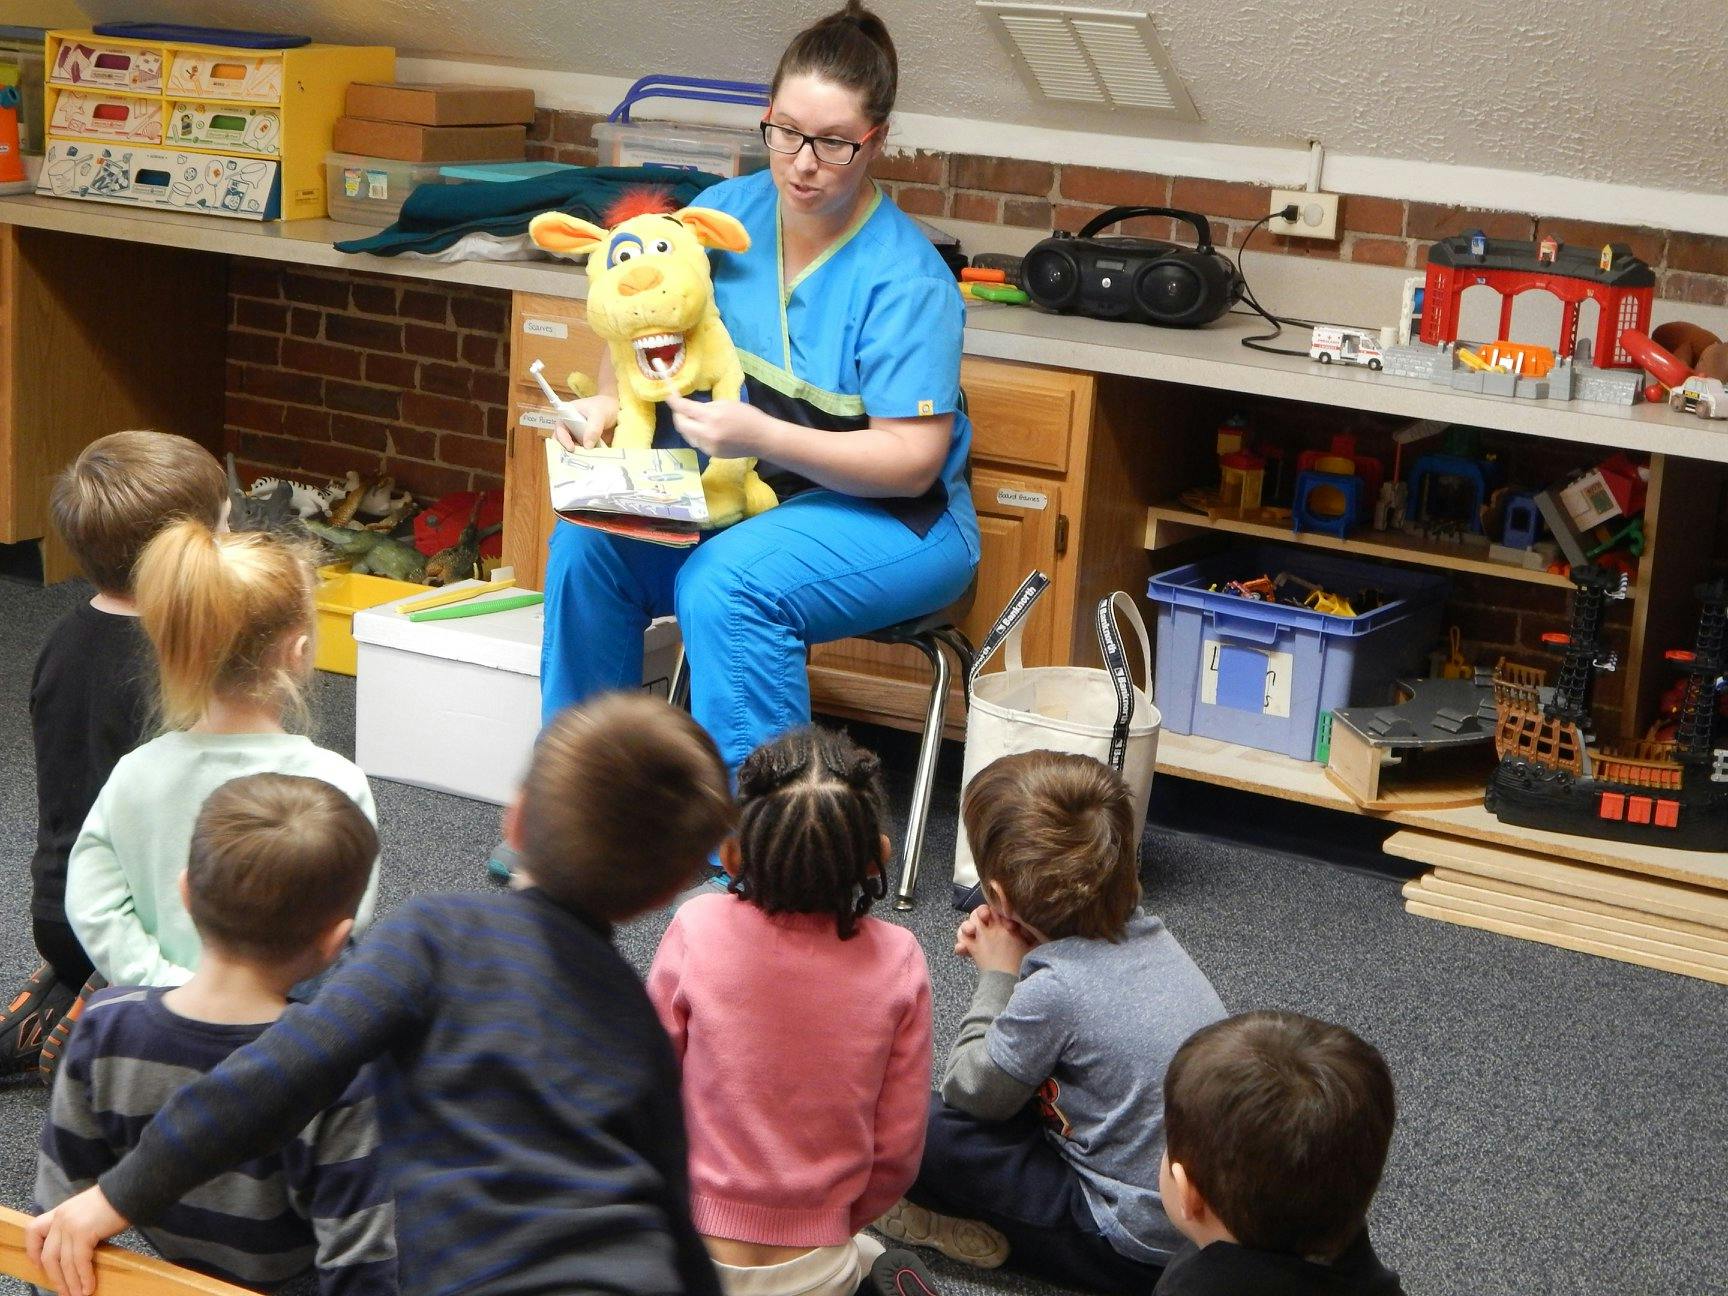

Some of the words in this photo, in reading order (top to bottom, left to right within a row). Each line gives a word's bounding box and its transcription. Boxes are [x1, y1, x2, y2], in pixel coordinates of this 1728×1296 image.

[528, 322, 553, 333] Scarves
[1003, 586, 1036, 626] Banknorth
[1100, 608, 1117, 655] Banknorth
